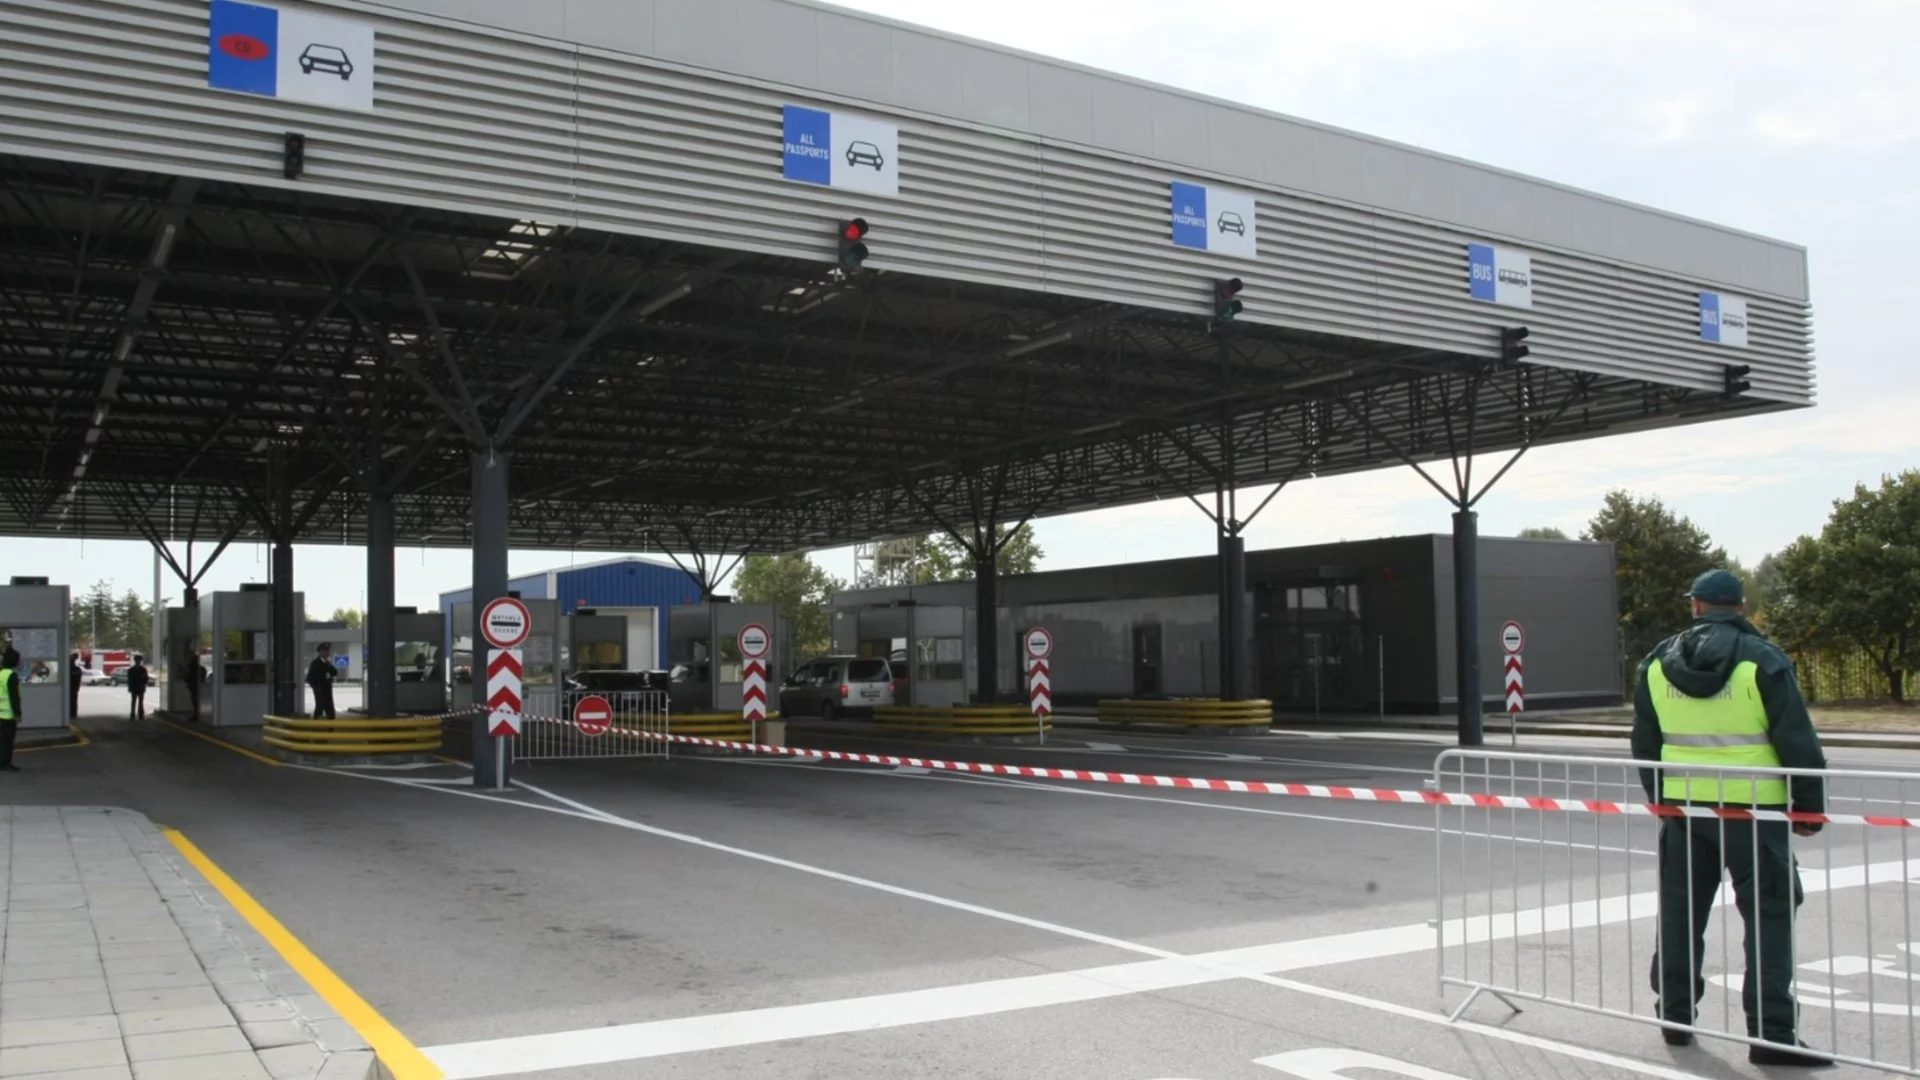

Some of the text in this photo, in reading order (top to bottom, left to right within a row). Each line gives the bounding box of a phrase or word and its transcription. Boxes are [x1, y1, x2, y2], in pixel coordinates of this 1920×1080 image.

[800, 133, 815, 145] ALL
[785, 142, 829, 160] PASSPORTS
[1472, 262, 1493, 282] BUS
